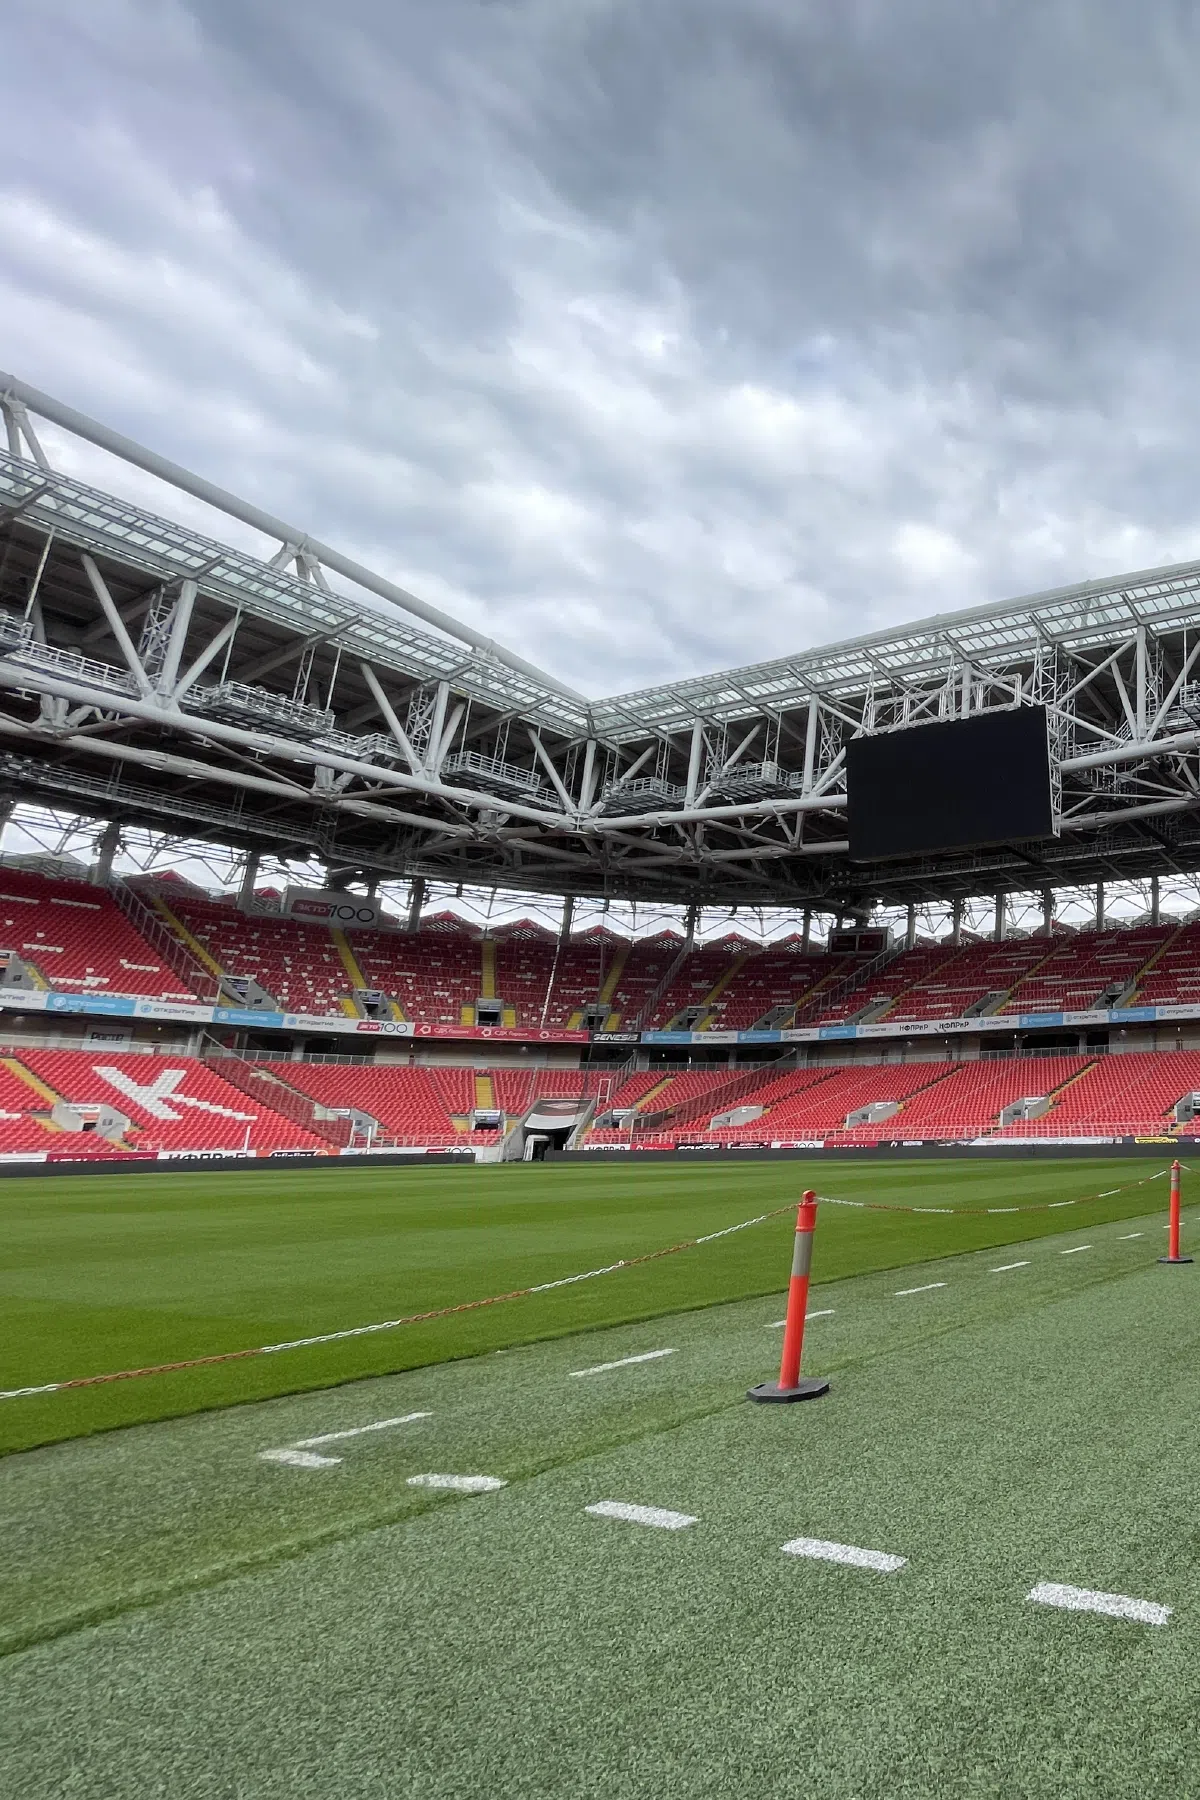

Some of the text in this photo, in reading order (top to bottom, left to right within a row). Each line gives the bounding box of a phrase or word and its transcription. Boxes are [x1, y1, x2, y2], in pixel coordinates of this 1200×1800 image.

[329, 905, 375, 922] 100
[380, 1022, 408, 1034] 100
[593, 1033, 638, 1042] GENESIS
